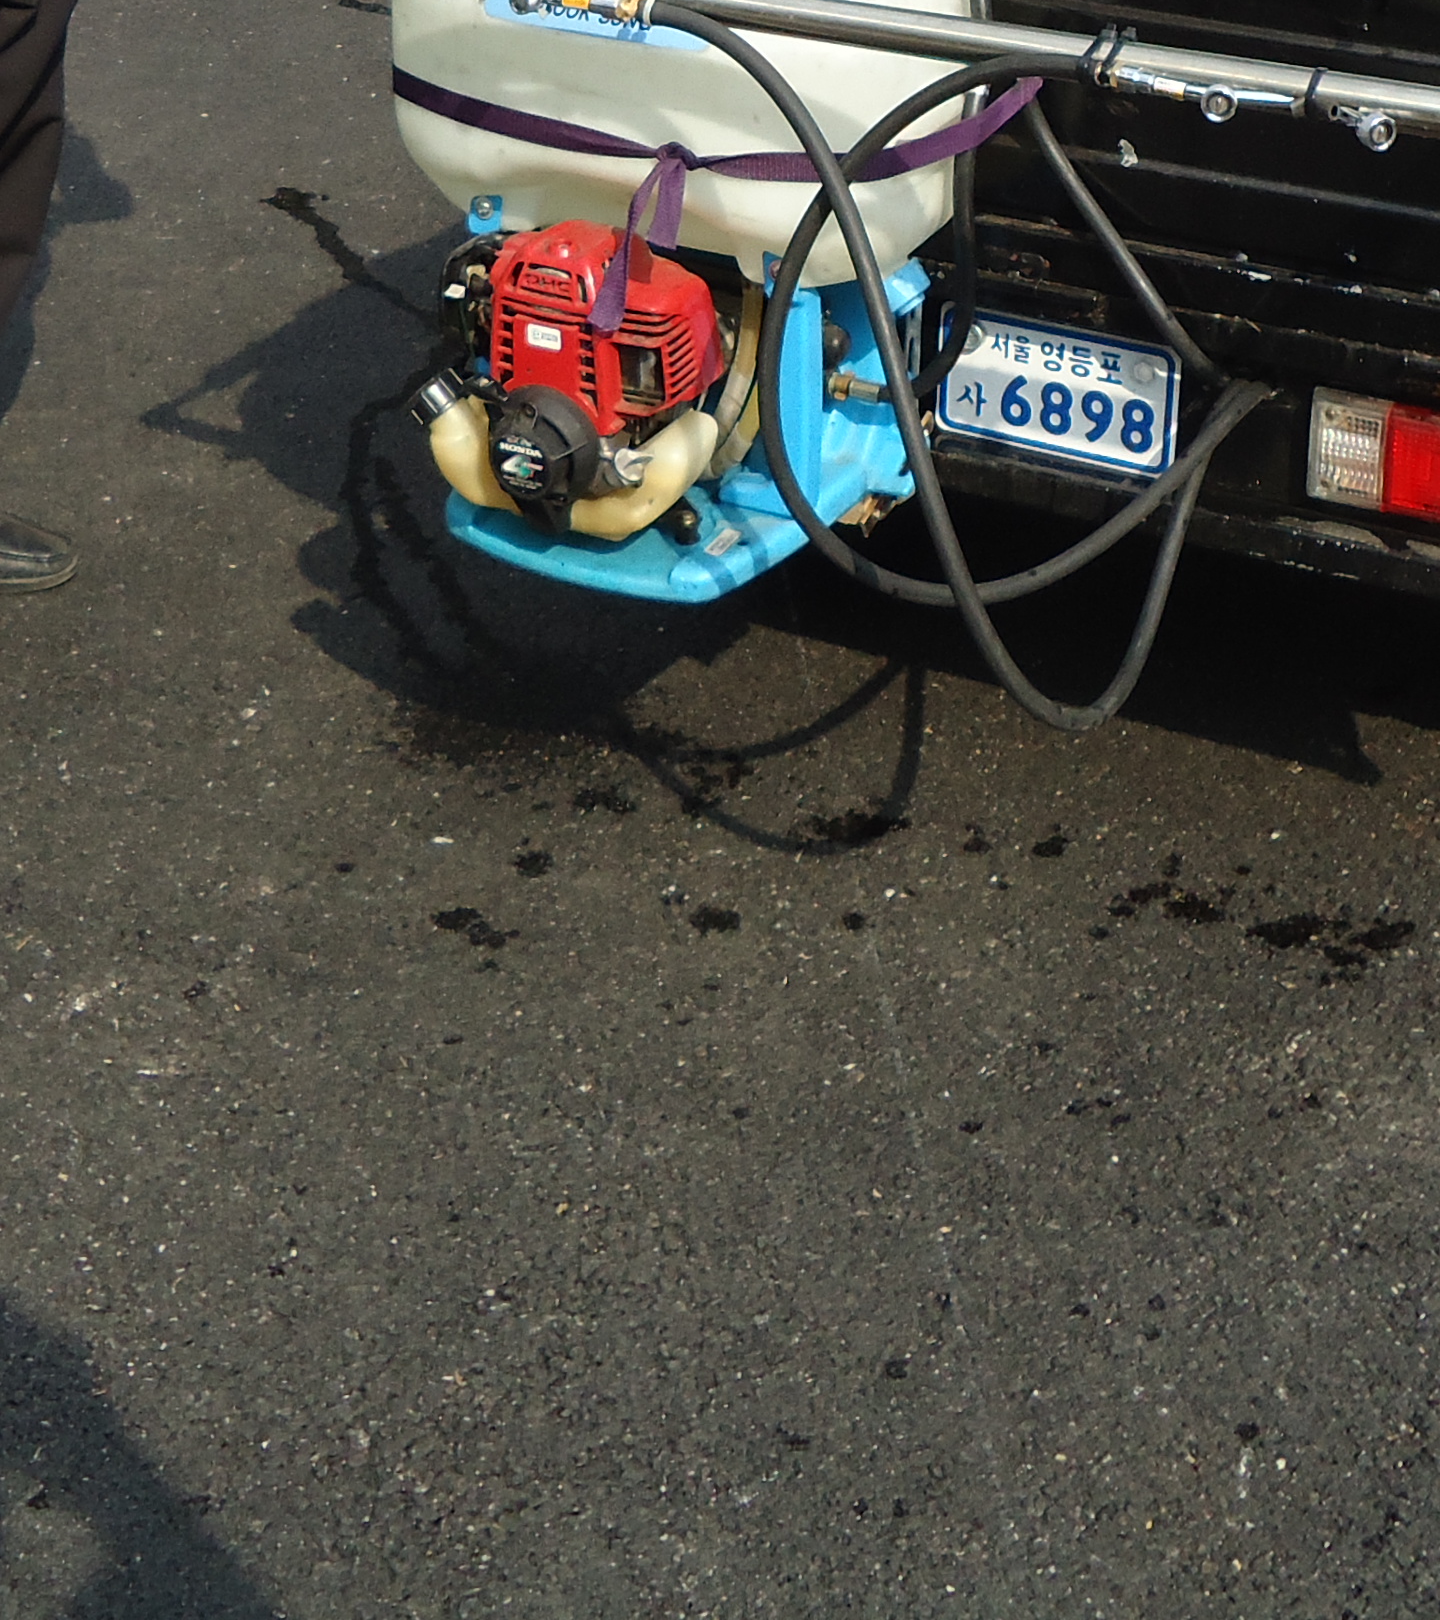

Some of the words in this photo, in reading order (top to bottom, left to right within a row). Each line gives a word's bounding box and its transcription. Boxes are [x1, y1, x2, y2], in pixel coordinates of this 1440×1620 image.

[991, 333, 1031, 364] 서울
[1041, 341, 1123, 386] 영등포
[956, 381, 987, 417] 사
[1000, 374, 1155, 455] 6898
[498, 441, 543, 459] HONDA
